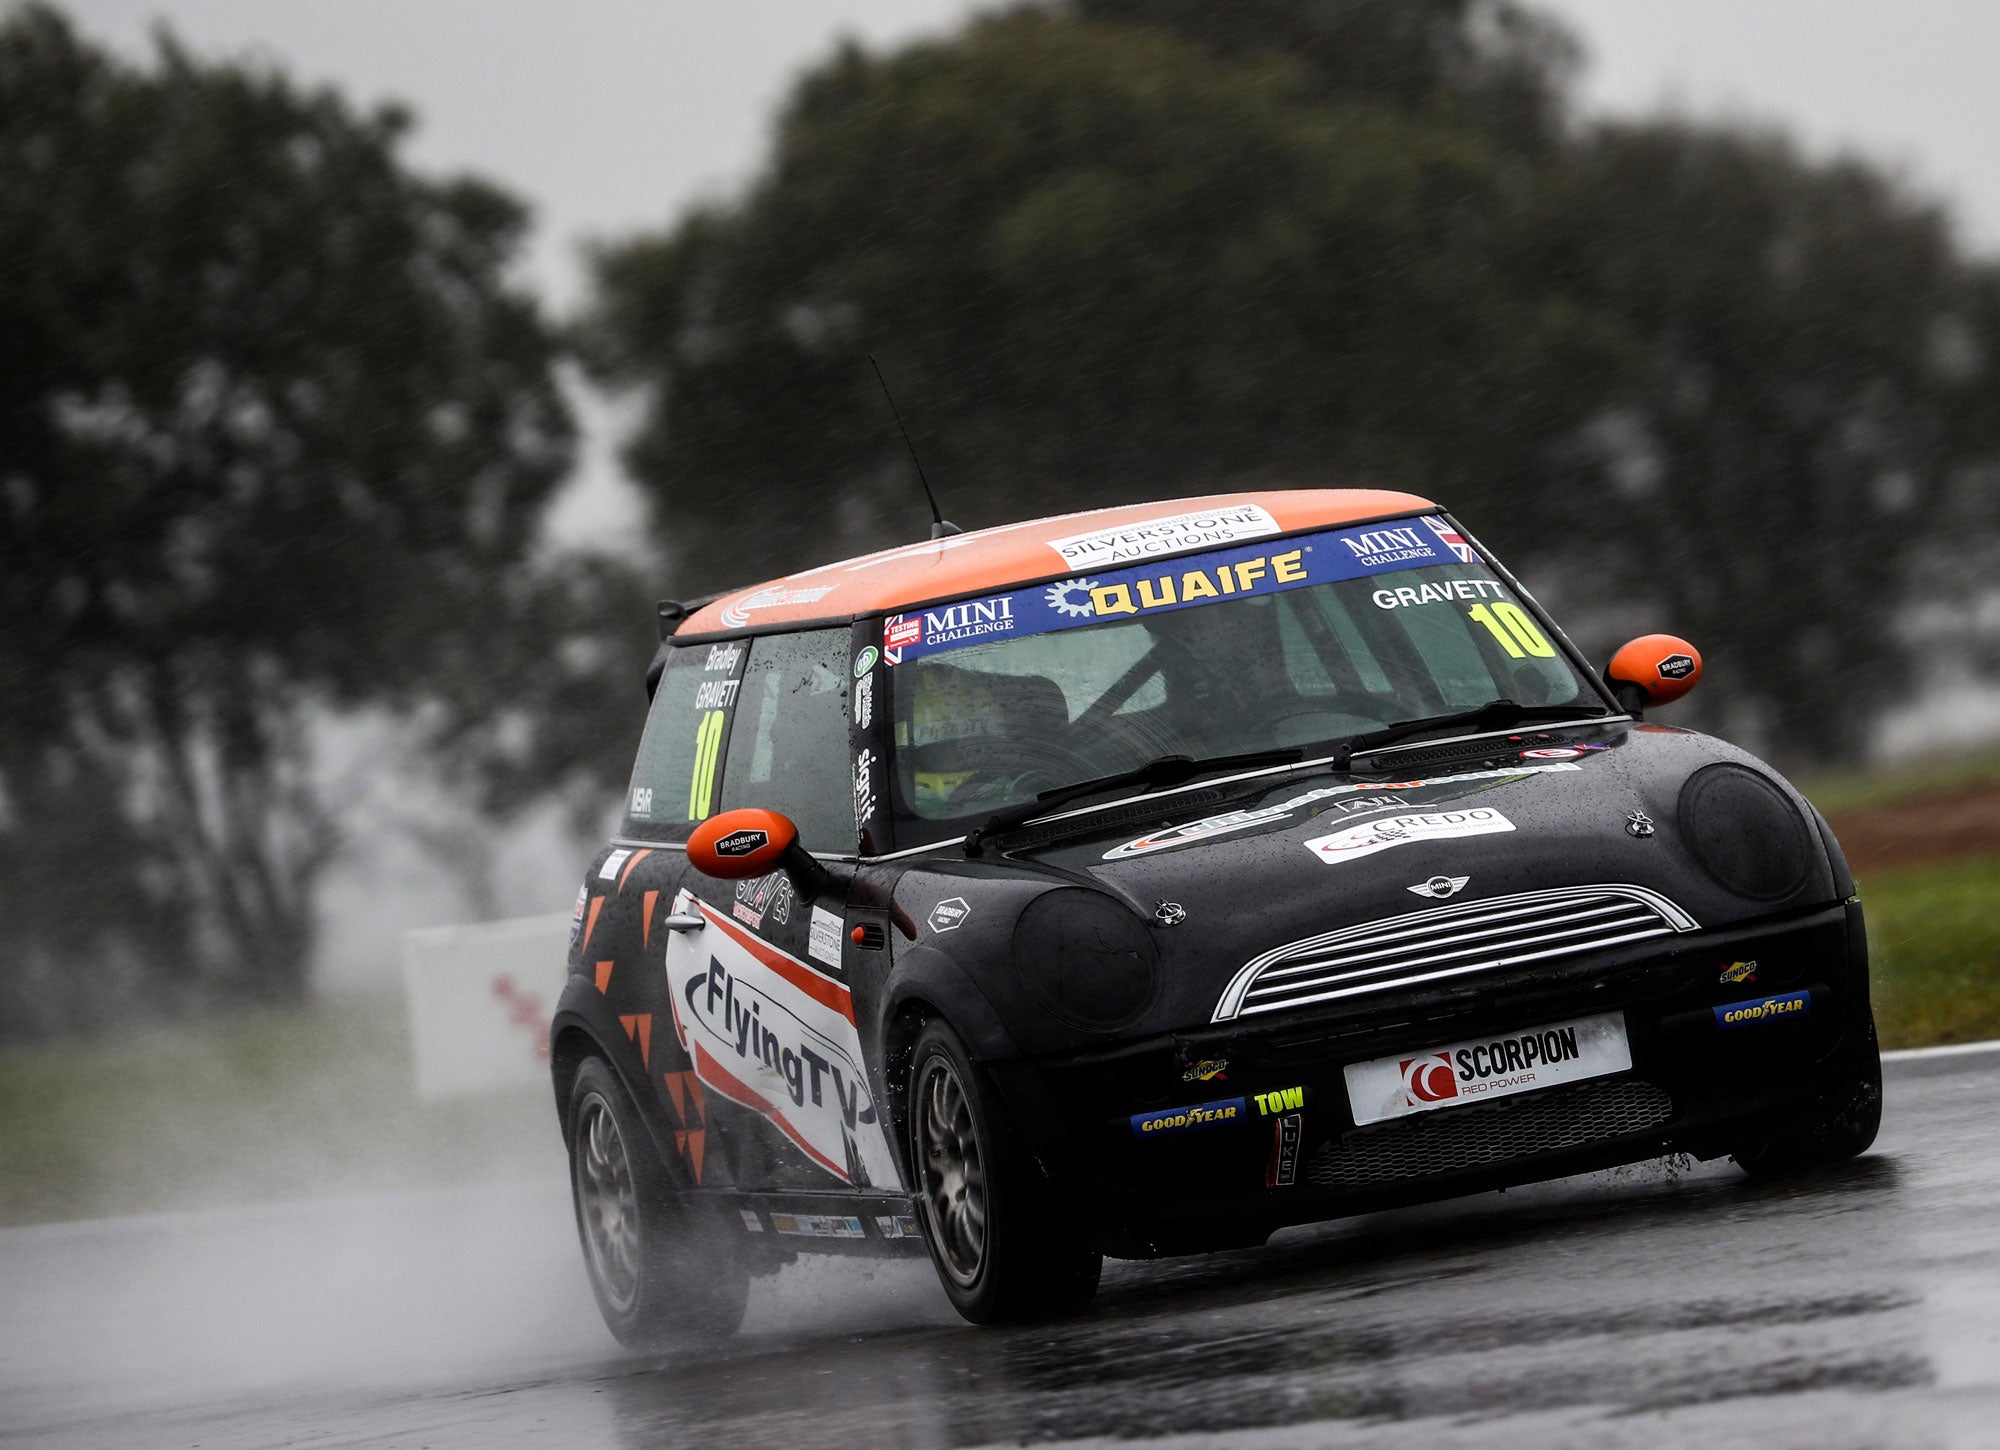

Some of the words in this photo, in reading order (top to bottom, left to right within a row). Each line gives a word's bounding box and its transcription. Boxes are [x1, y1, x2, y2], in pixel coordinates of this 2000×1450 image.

[1062, 511, 1263, 558] SILVERSTONE
[1112, 528, 1235, 561] AUCTIONS
[1340, 527, 1428, 557] MINI
[1361, 547, 1436, 567] CHALLENGE
[1089, 549, 1309, 616] QUAIFE
[1372, 579, 1505, 610] GRAVETT
[891, 620, 919, 634] TESTING
[924, 597, 1014, 635] MINI
[926, 619, 1014, 645] CHALLENGE
[1468, 602, 1556, 658] 10
[705, 643, 741, 676] Bradley
[1661, 659, 1691, 671] BRADBURY
[695, 679, 740, 709] GRAVETT
[688, 710, 724, 820] 10
[856, 748, 877, 824] signit
[1372, 810, 1493, 832] CREDO
[720, 833, 761, 849] BRADBURY
[731, 843, 751, 852] RACING
[1430, 881, 1451, 891] MINI
[935, 905, 965, 918] BRADBURY
[809, 926, 841, 952] SILVERSTONE
[1719, 960, 1757, 983] SUNOCO
[1724, 999, 1804, 1023] GOODYEAR
[707, 953, 858, 1132] FlyingTV
[1456, 1026, 1580, 1082] SCORPION
[1183, 1059, 1228, 1081] SUNOCO
[1462, 1082, 1487, 1096] RED
[1490, 1073, 1536, 1091] POWER
[1254, 1086, 1304, 1116] TOW
[1141, 1106, 1236, 1132] GOODYEAR
